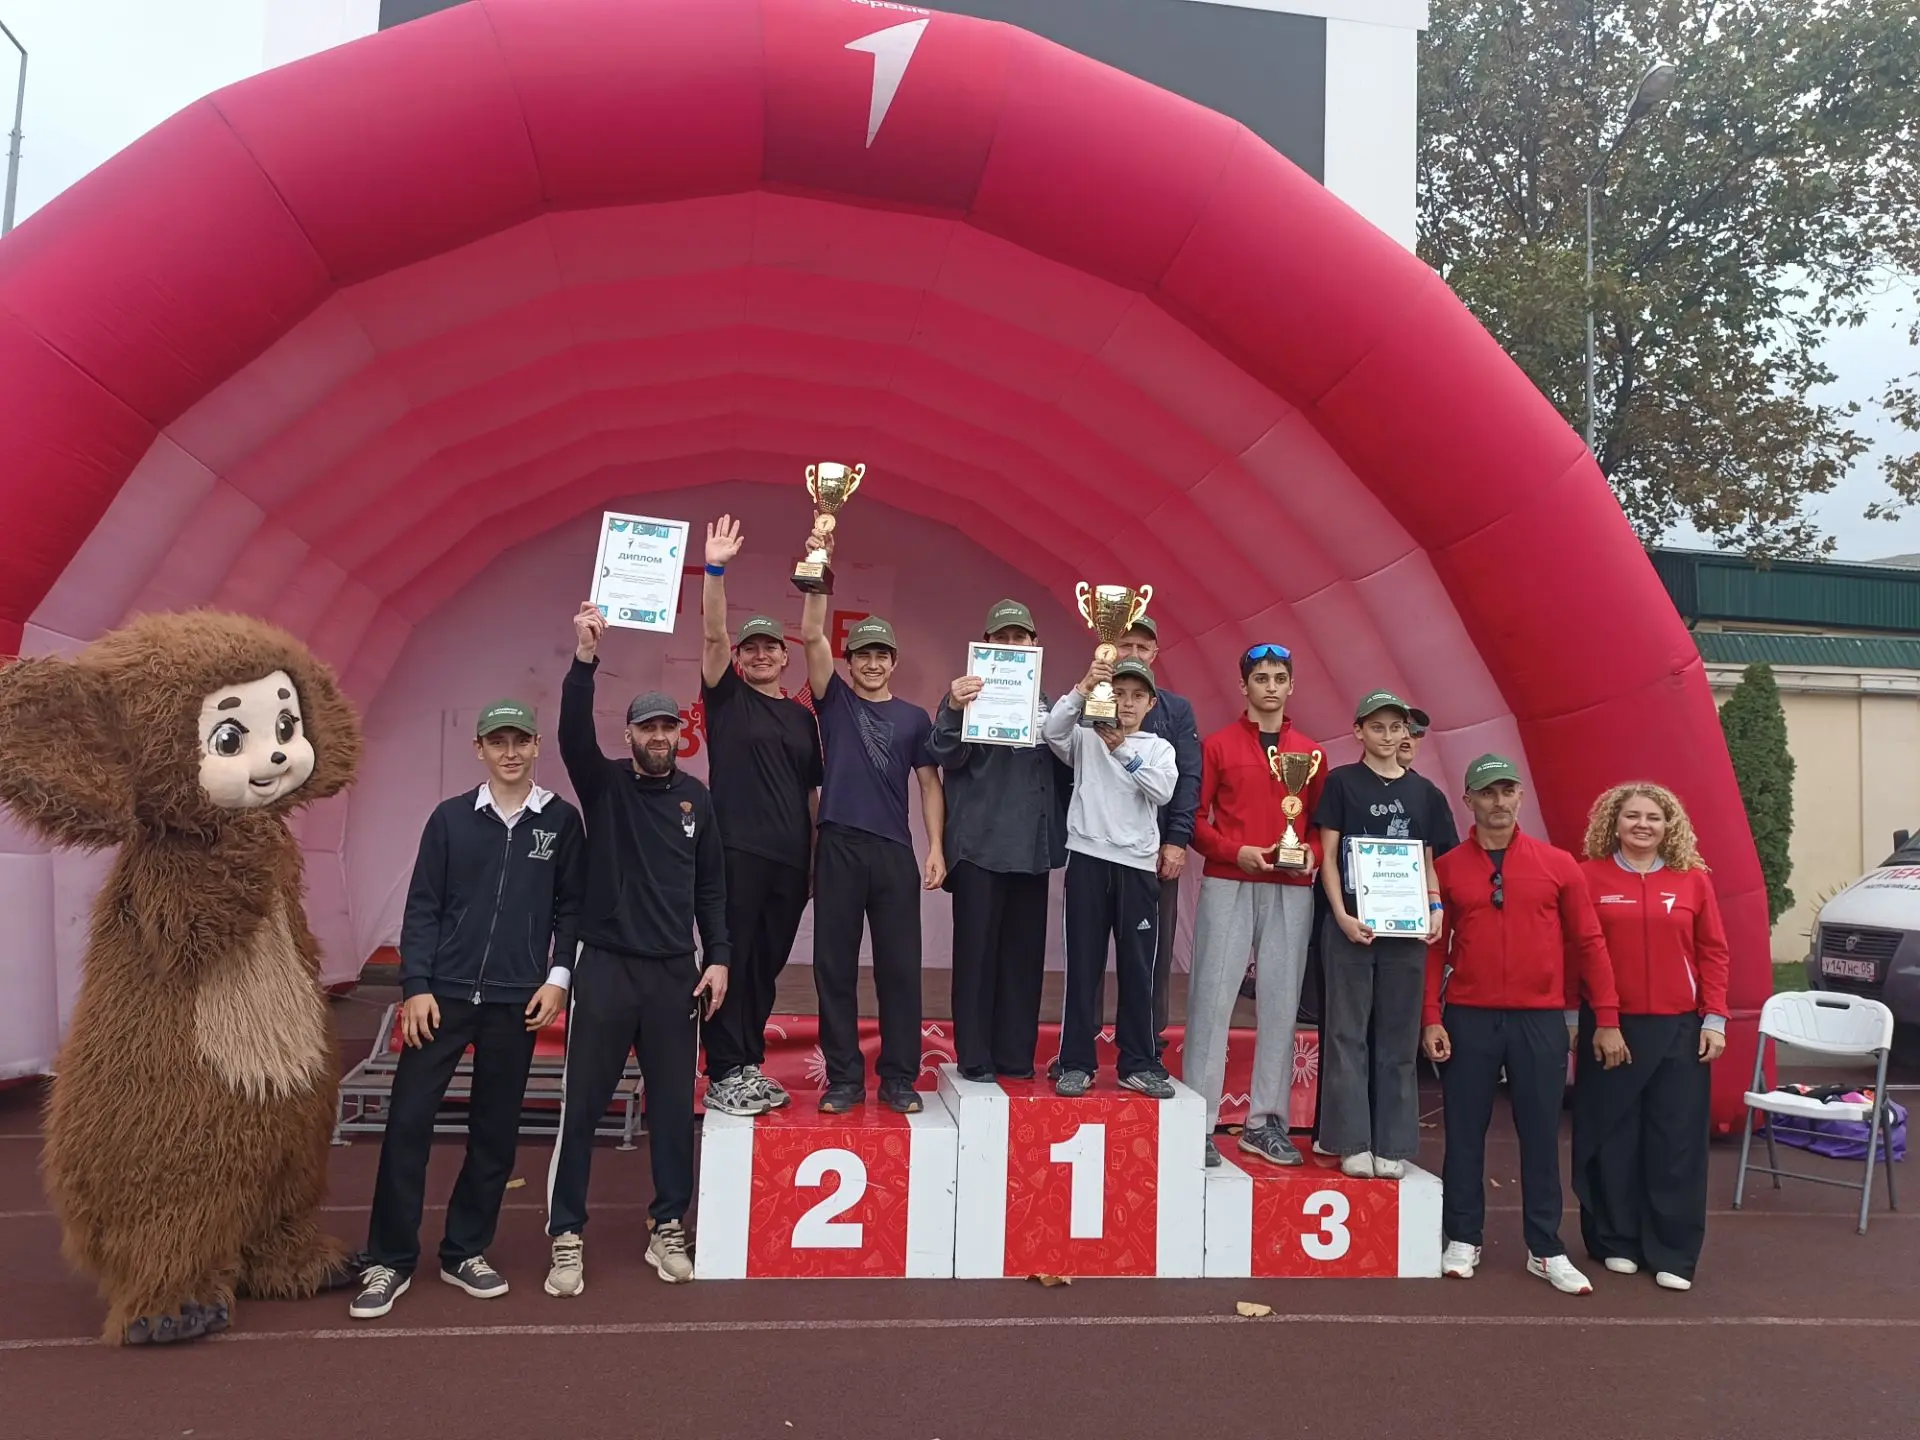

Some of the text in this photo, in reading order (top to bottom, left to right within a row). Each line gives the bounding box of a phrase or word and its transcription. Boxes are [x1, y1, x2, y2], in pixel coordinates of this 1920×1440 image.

[618, 552, 663, 564] ДИПЛОМ
[984, 677, 1022, 687] ДИПЛОМ
[1372, 871, 1409, 879] ДИПЛОМ
[791, 1148, 867, 1249] 2
[1049, 1123, 1105, 1239] 1
[1300, 1190, 1351, 1261] 3
